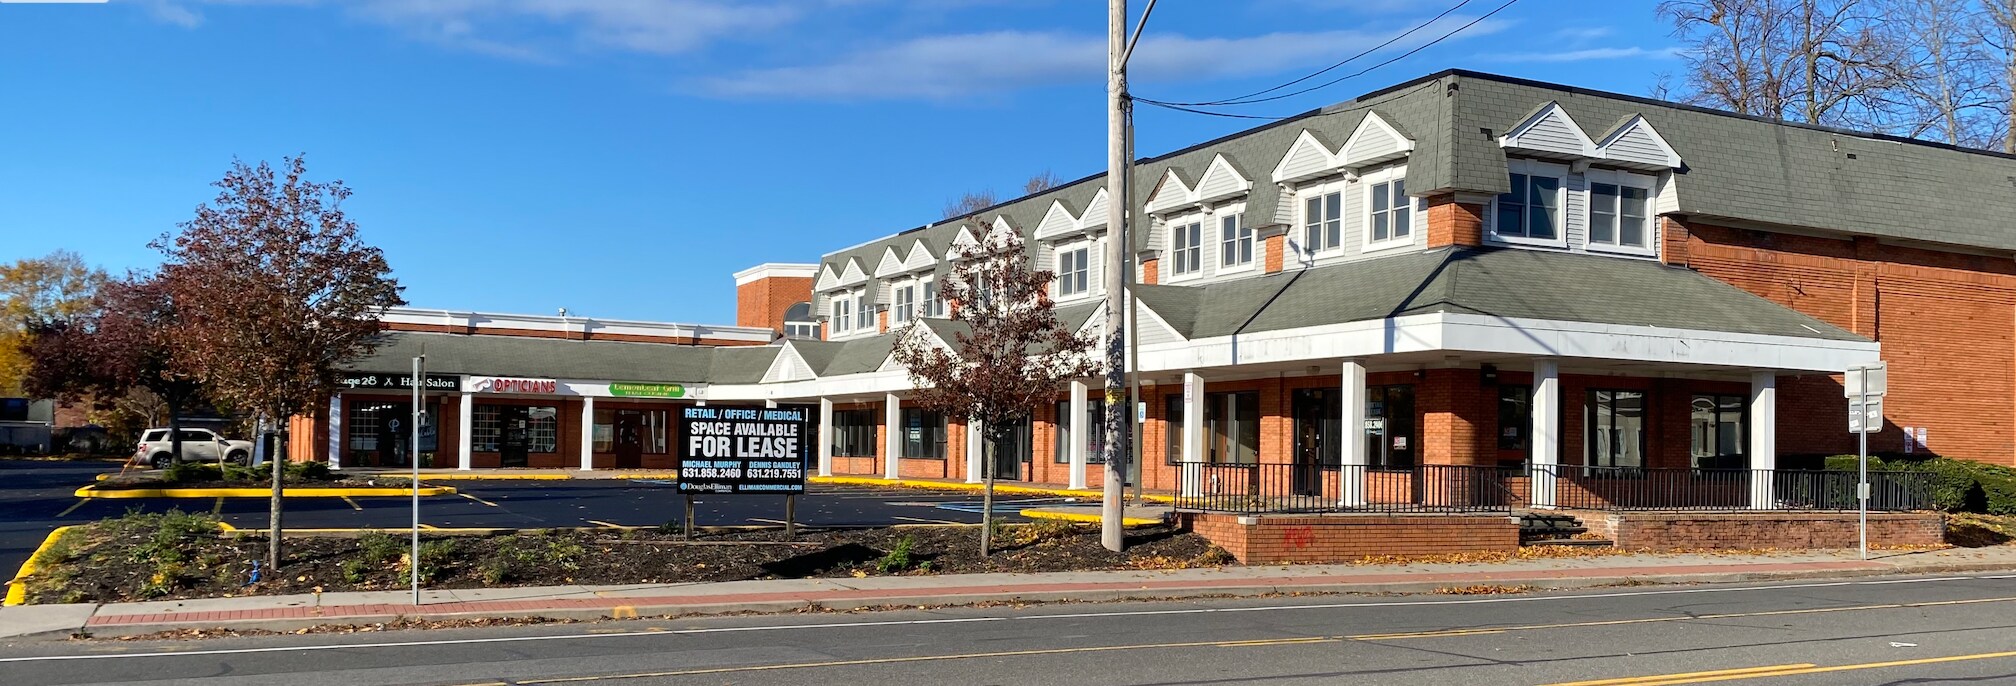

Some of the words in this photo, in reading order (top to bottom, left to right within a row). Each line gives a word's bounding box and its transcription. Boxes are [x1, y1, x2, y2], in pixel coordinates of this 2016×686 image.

[401, 377, 422, 386] Har
[426, 378, 455, 388] Salon
[493, 378, 556, 393] OPTICIANS
[685, 408, 717, 419] RETAIL
[724, 409, 757, 420] OFFICE
[764, 410, 802, 421] MEDICAL
[690, 422, 731, 435] SPACE
[734, 423, 798, 437] AVAILABLE
[690, 436, 731, 457] FOR
[736, 437, 798, 458] LEASE
[682, 461, 713, 469] MICHAEL
[713, 461, 742, 469] MURPHY
[749, 461, 772, 469] DENNIS
[682, 468, 742, 479] 631.858.2460
[746, 468, 801, 479] 631.219.7551
